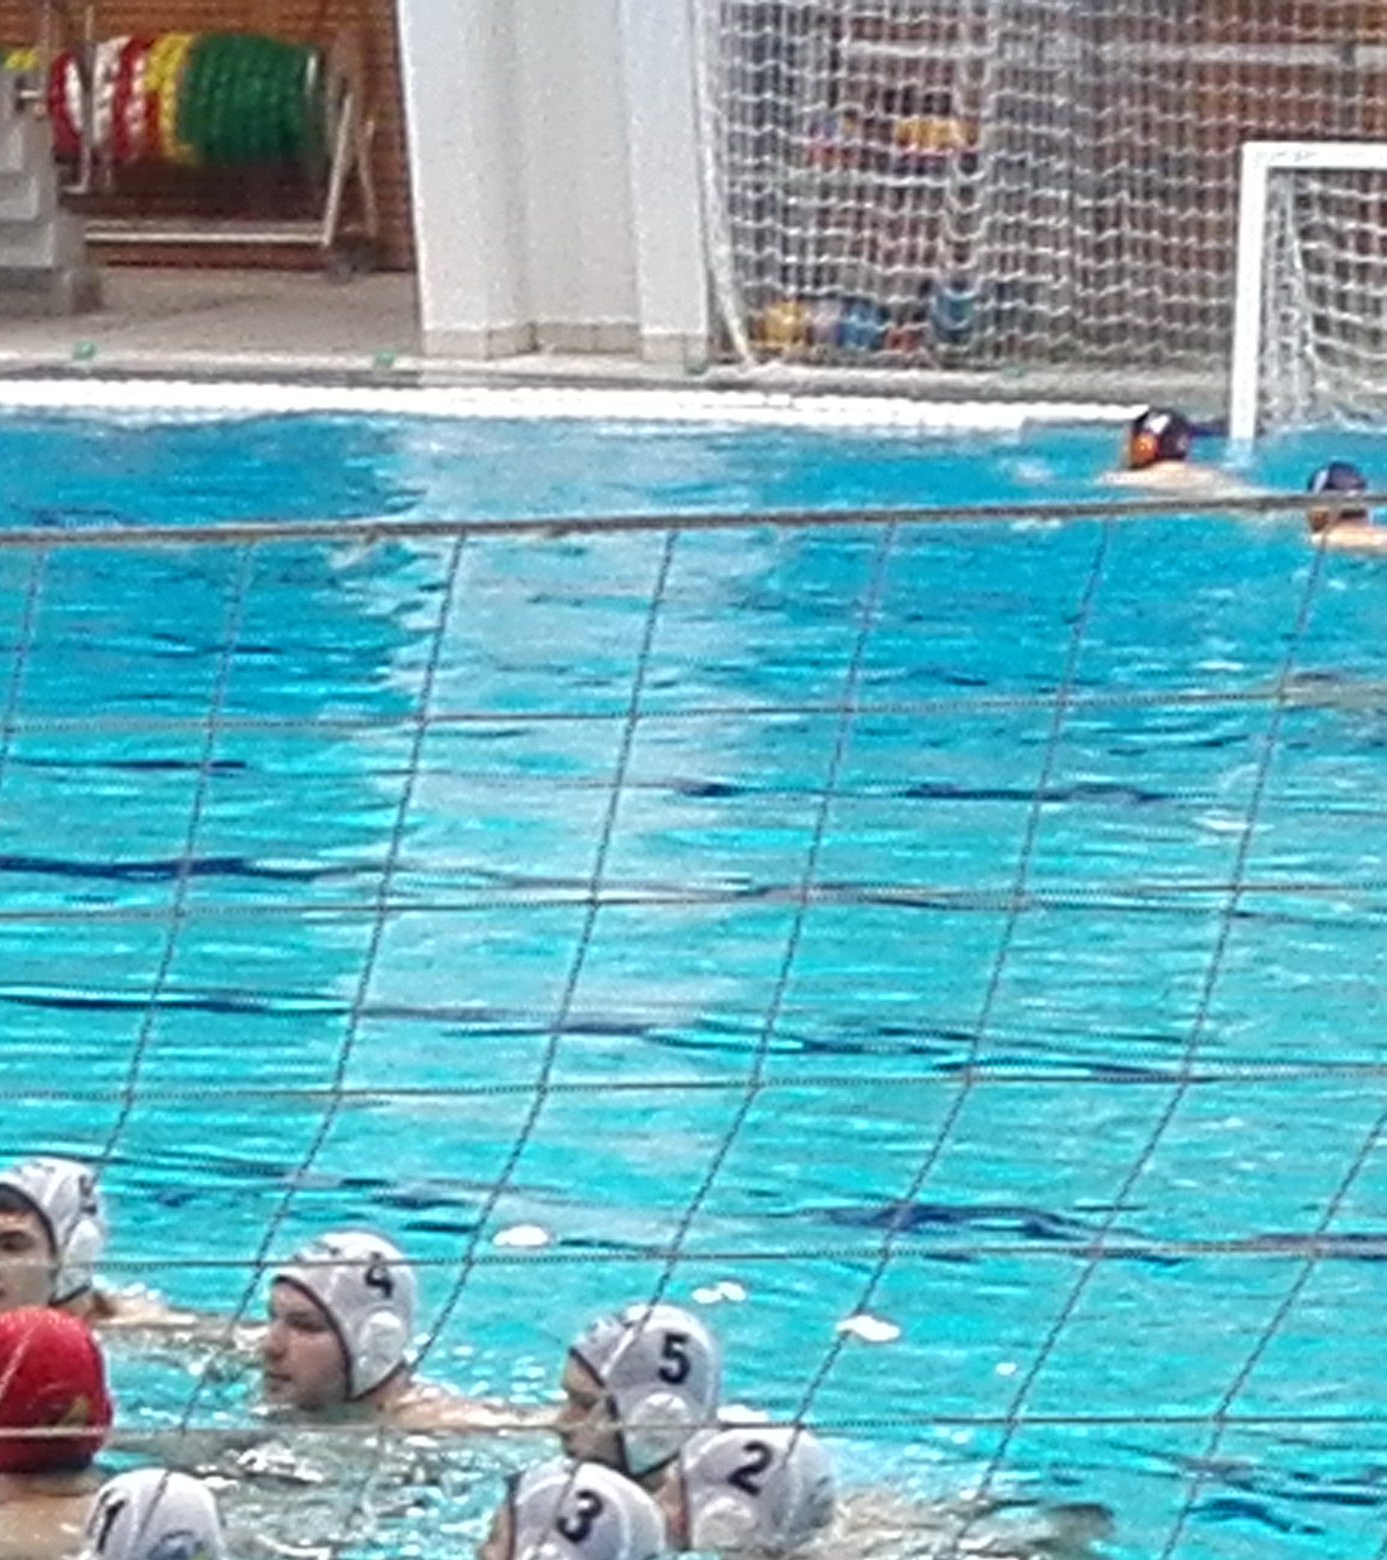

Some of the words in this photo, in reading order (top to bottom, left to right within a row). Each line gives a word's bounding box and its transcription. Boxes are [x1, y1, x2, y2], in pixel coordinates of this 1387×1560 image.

[658, 1331, 690, 1385] 5
[727, 1440, 773, 1496] 2
[556, 1489, 603, 1544] 3
